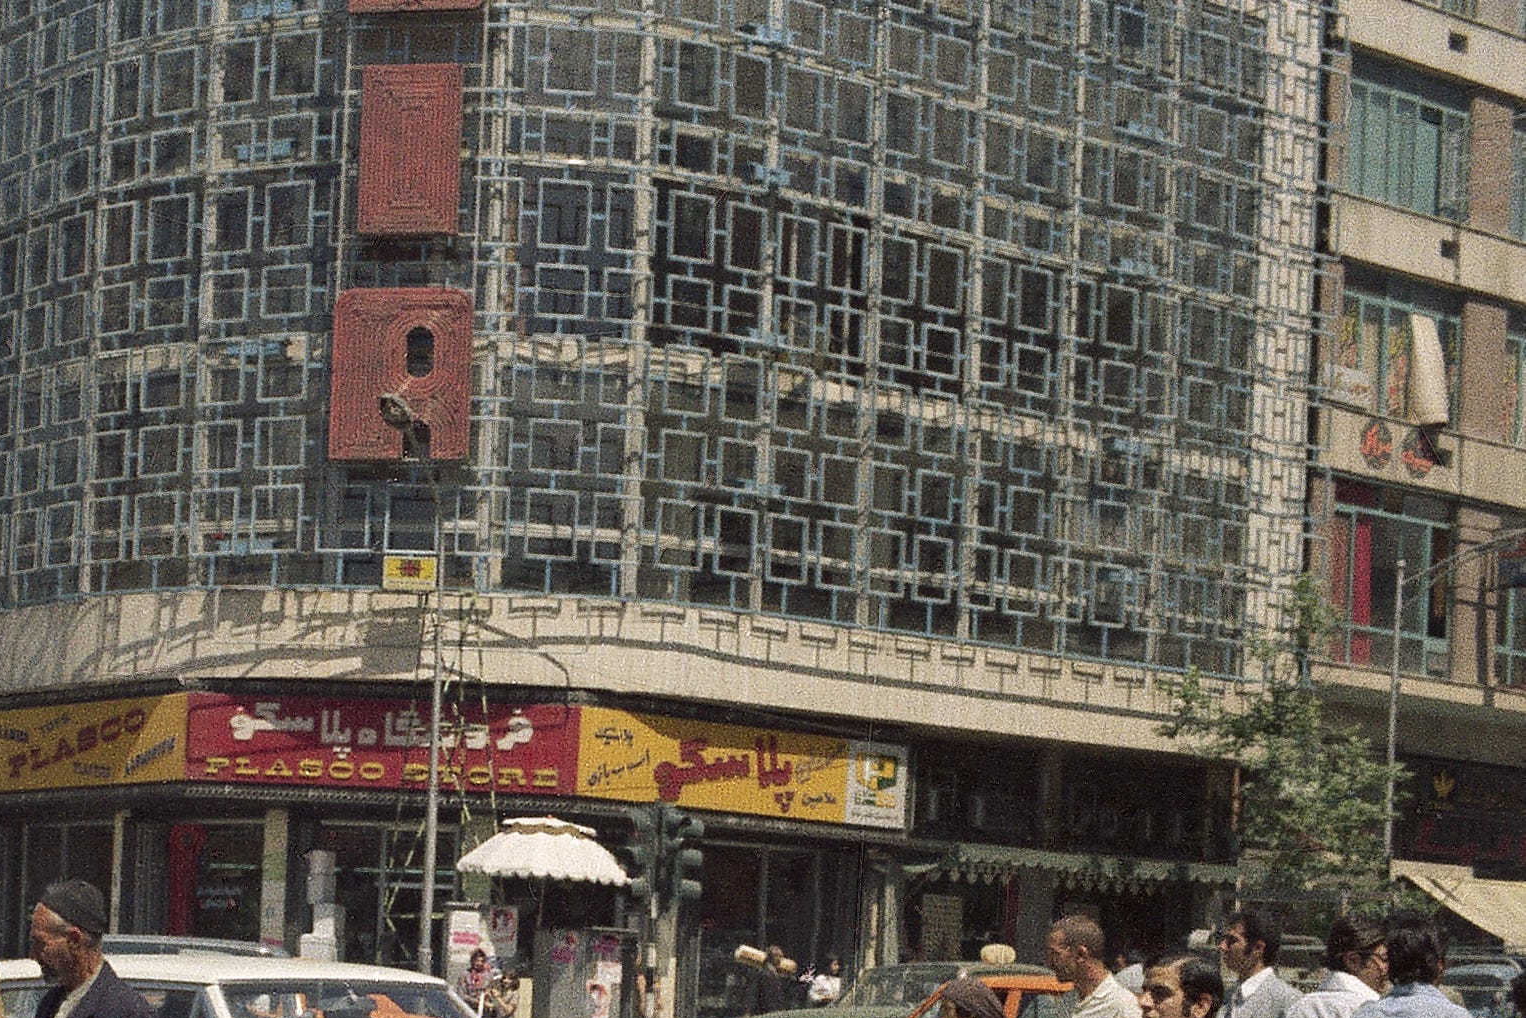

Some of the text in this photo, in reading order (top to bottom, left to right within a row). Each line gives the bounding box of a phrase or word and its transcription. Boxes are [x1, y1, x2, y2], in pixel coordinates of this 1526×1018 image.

[7, 708, 147, 779] PLASCO
[229, 700, 352, 759] پلاسکو
[204, 757, 559, 787] PLASCO STORE
[653, 736, 793, 812] پلاسکو
